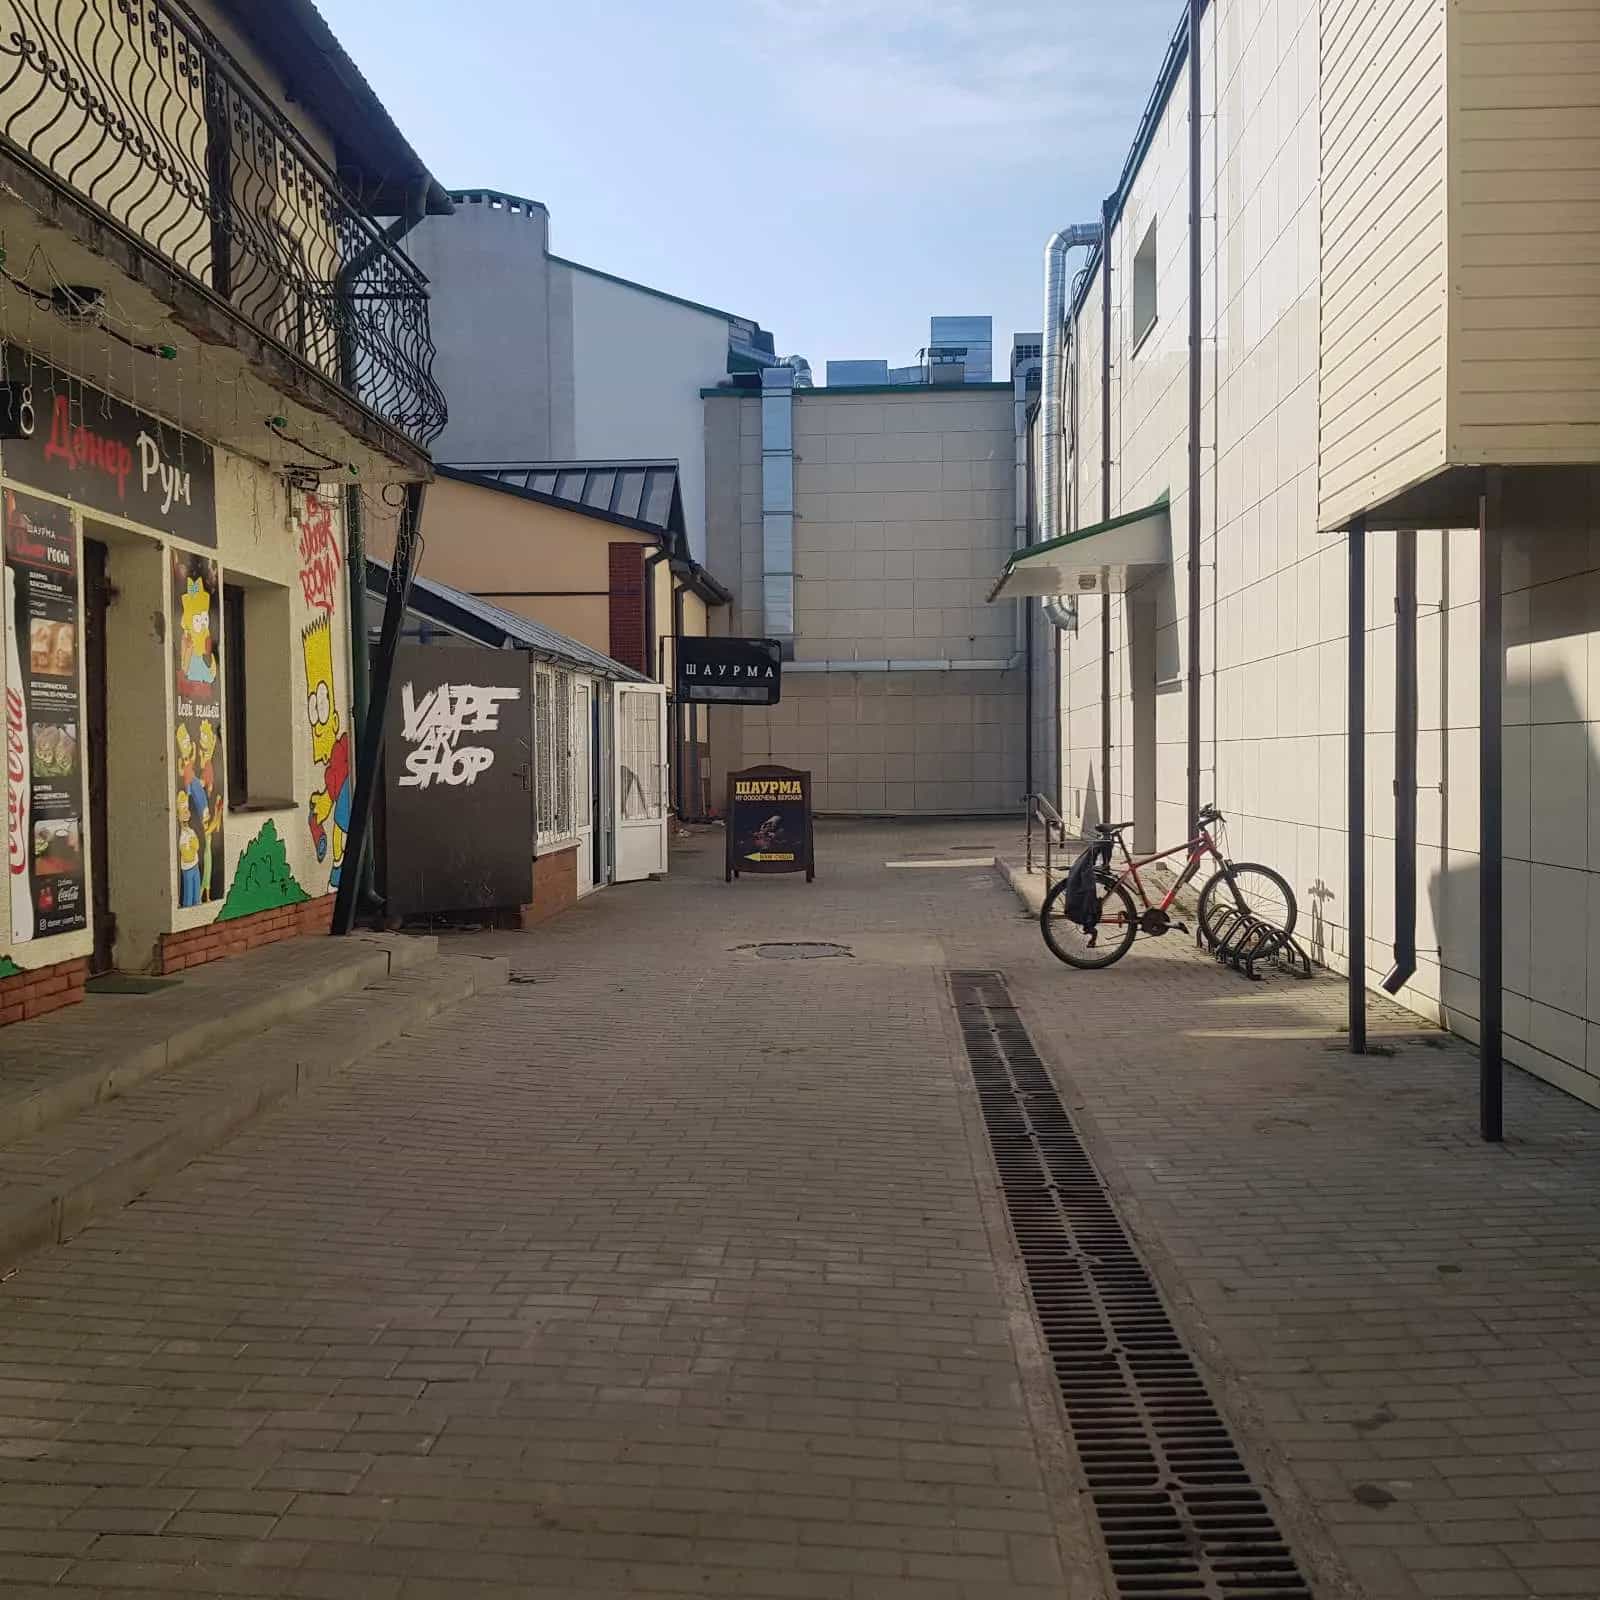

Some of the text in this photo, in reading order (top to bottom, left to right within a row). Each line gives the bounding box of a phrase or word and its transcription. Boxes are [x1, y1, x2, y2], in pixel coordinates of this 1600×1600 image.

[43, 395, 191, 515] Донер Рум
[685, 662, 775, 678] ШАУРМА
[401, 680, 520, 742] VAPE
[415, 725, 461, 757] ART
[398, 746, 495, 790] SHOP
[735, 780, 802, 795] ШАУРМА
